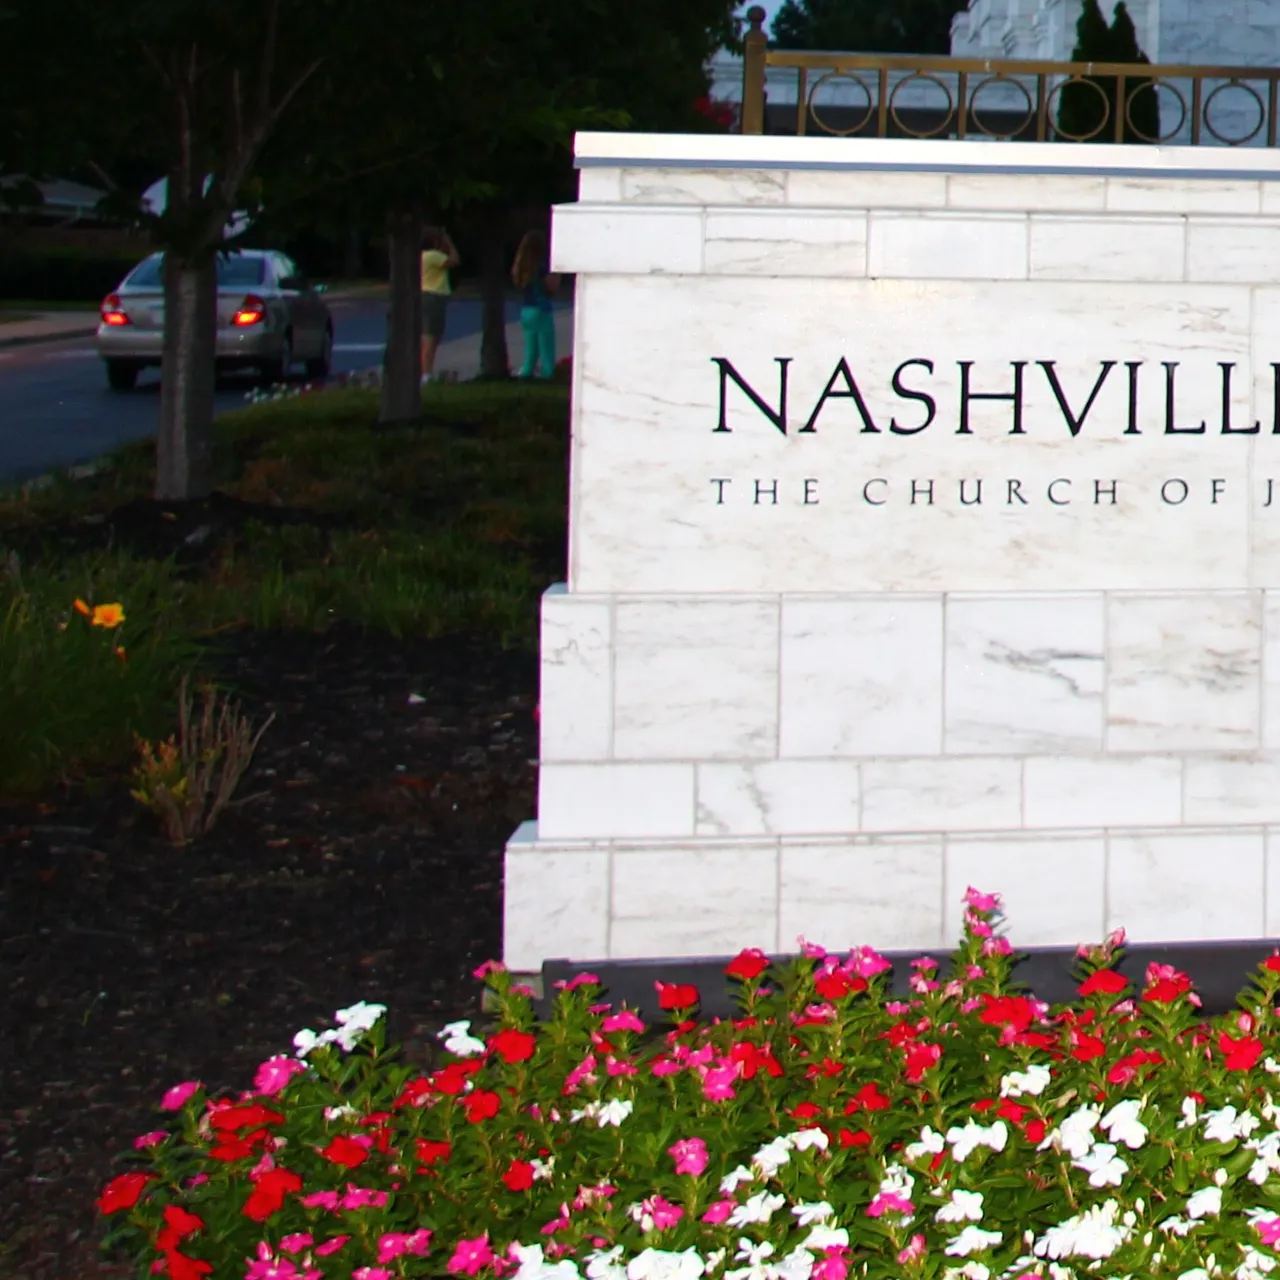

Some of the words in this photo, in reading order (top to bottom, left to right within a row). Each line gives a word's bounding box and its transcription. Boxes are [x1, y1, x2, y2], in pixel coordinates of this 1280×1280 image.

[710, 478, 820, 505] THE
[862, 478, 1118, 506] CHURCH
[1160, 478, 1227, 505] OF
